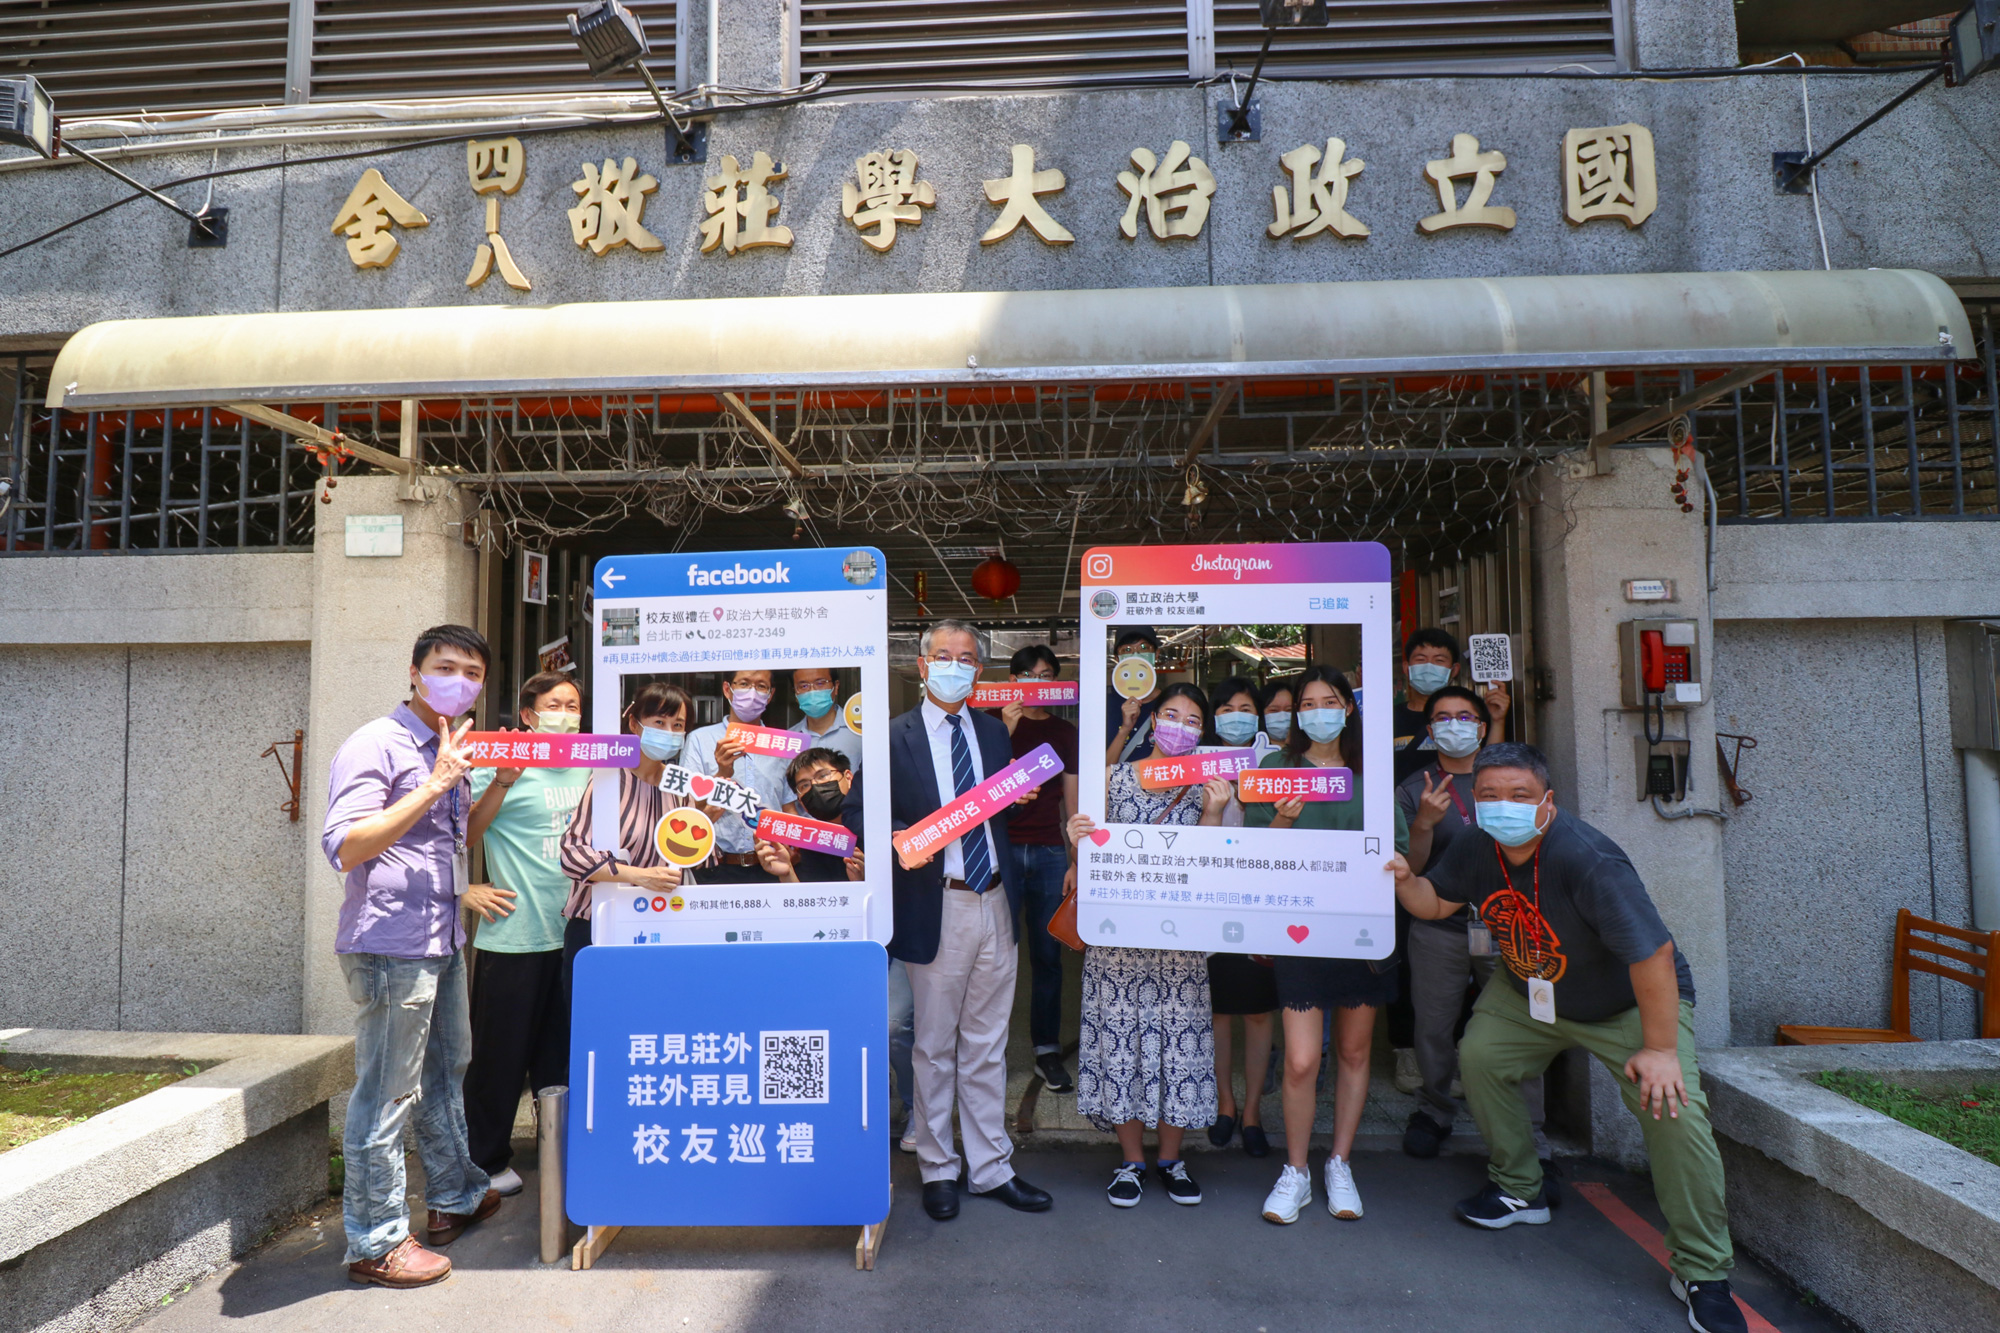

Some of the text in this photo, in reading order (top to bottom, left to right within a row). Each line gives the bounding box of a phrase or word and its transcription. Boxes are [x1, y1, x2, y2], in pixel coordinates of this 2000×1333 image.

[687, 561, 790, 587] facebook
[1191, 553, 1273, 581] Instagram
[1125, 591, 1200, 604] 國立政治大學
[1308, 597, 1350, 610] 已追蹤
[645, 605, 829, 625] 校友巡禮在 政治大學莊敬外舍
[1125, 605, 1206, 616] 莊敬外舍 校友巡禮
[645, 626, 786, 642] 台北市 02-8237-2349
[728, 727, 803, 754] #珍重再見
[663, 767, 760, 820] 我 政大
[1242, 775, 1347, 795] #我的主場秀
[760, 815, 850, 852] #像極了愛情
[1089, 869, 1189, 885] 莊敬外舍 校友巡禮
[689, 896, 850, 911] 你和其他16,888人 88,888次分享
[1089, 886, 1157, 901] #莊外我的家
[741, 930, 763, 942] 留言
[828, 928, 851, 940] 分享
[627, 1031, 753, 1066] 再見莊外
[627, 1073, 753, 1107] 莊外再見
[631, 1122, 815, 1165] 校友巡禮
